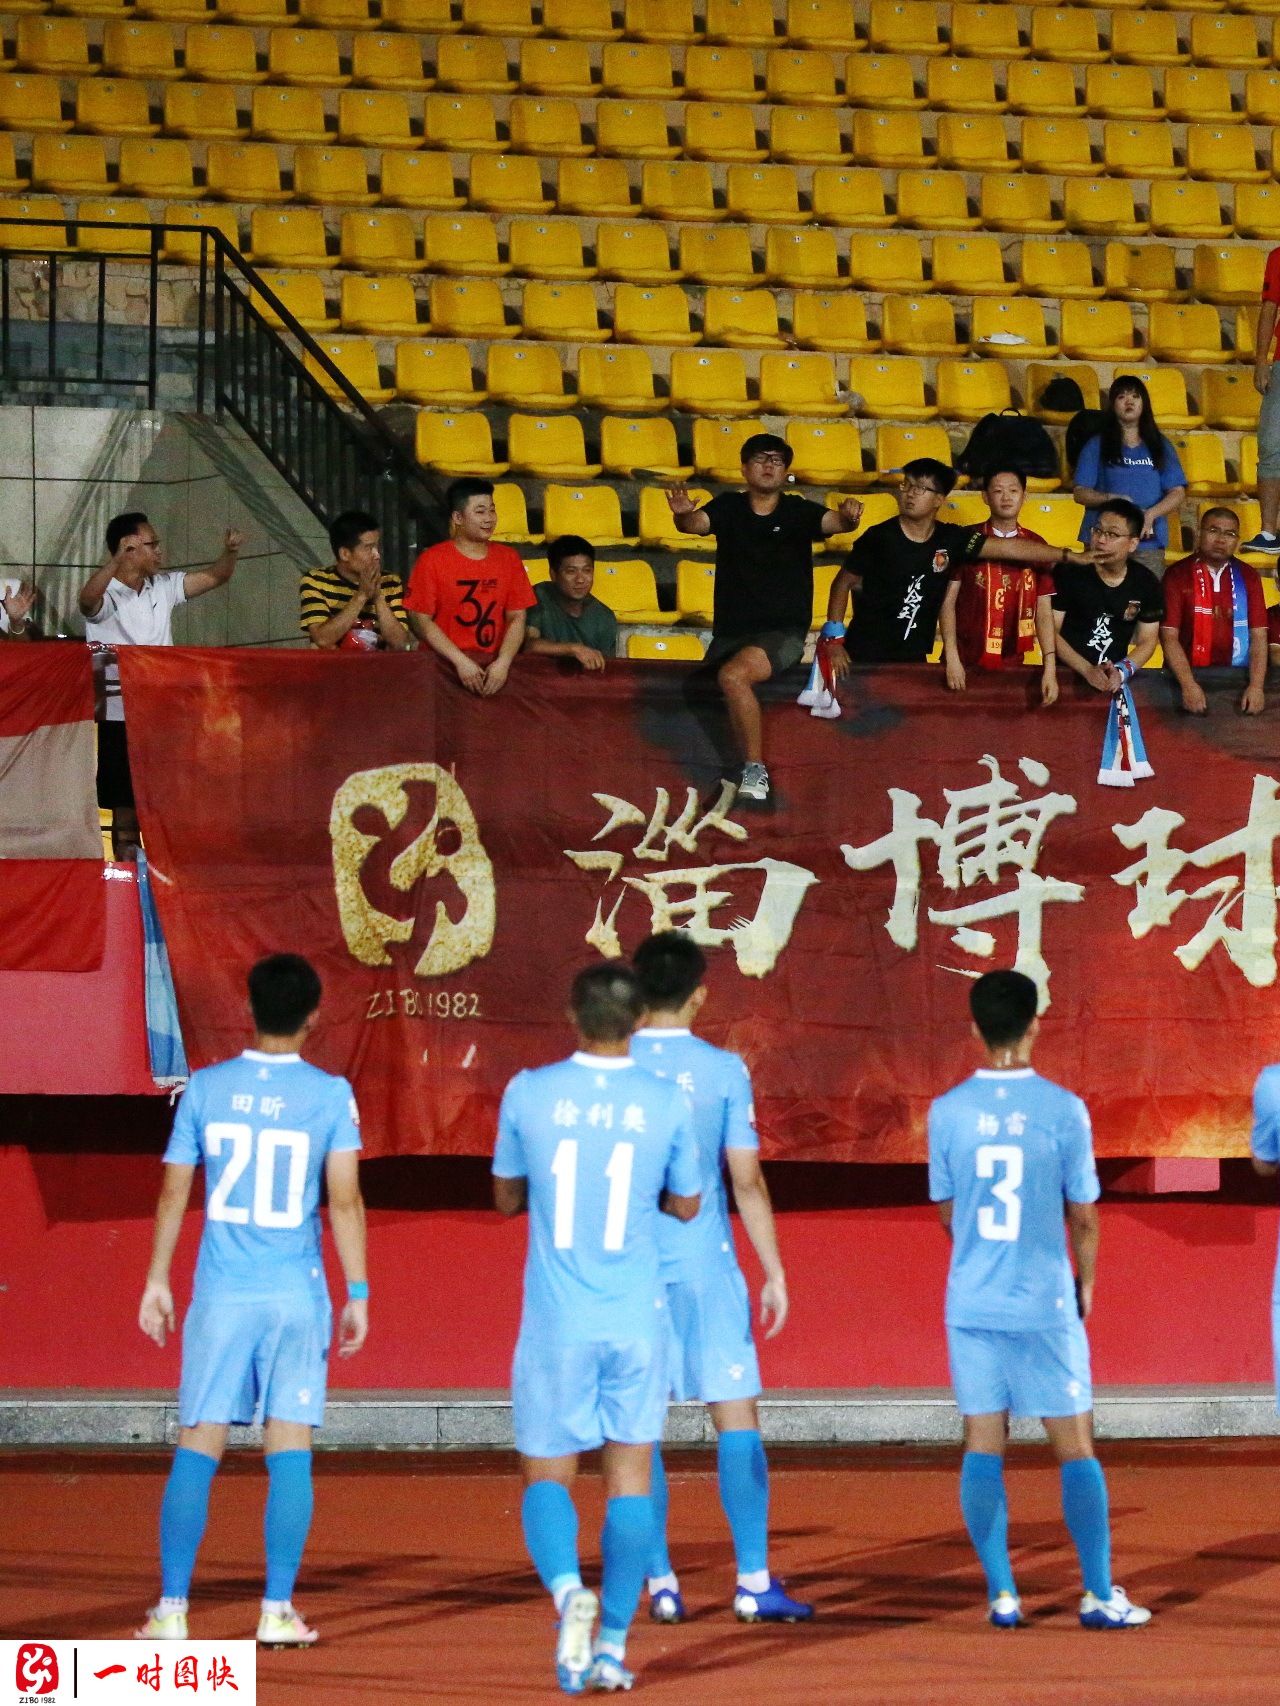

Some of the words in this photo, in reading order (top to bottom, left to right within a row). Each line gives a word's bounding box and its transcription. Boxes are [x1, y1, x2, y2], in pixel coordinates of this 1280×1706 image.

[456, 580, 497, 647] 36
[428, 991, 482, 1018] 1982
[231, 1093, 286, 1121] 田昕
[205, 1122, 309, 1228] 20
[551, 1139, 634, 1251] 11
[976, 1145, 1024, 1241] 3
